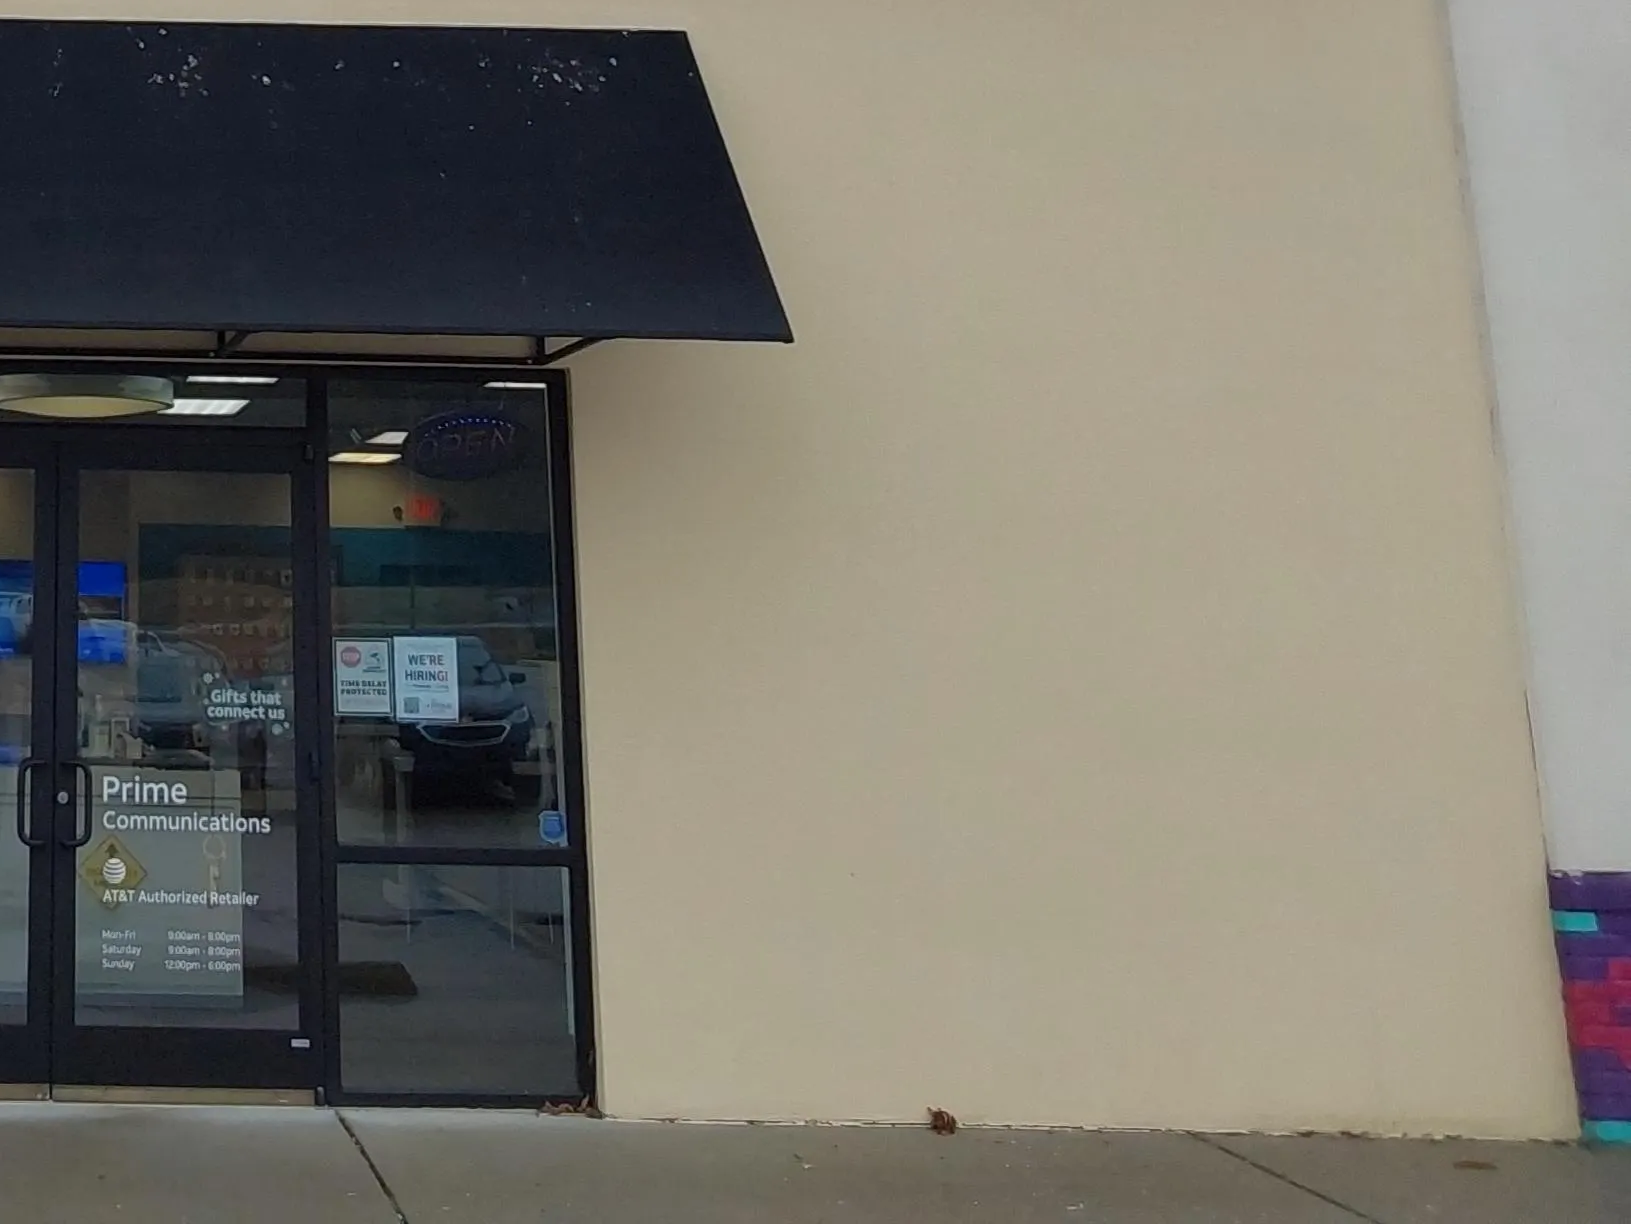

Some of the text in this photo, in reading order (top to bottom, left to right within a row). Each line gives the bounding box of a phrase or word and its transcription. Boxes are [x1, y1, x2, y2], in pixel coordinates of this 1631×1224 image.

[407, 654, 445, 666] WE'RE
[404, 669, 449, 682] HIRING!
[211, 688, 282, 706] Gifts that
[340, 688, 387, 696] PROTECTED
[207, 705, 286, 721] connect us
[102, 775, 188, 804] Prime
[102, 810, 272, 834] Communications
[102, 889, 260, 906] AT&T Authorized Retailer
[101, 929, 136, 940] Mon-Fri
[101, 944, 142, 956] Saturday
[101, 958, 135, 971] Sunday
